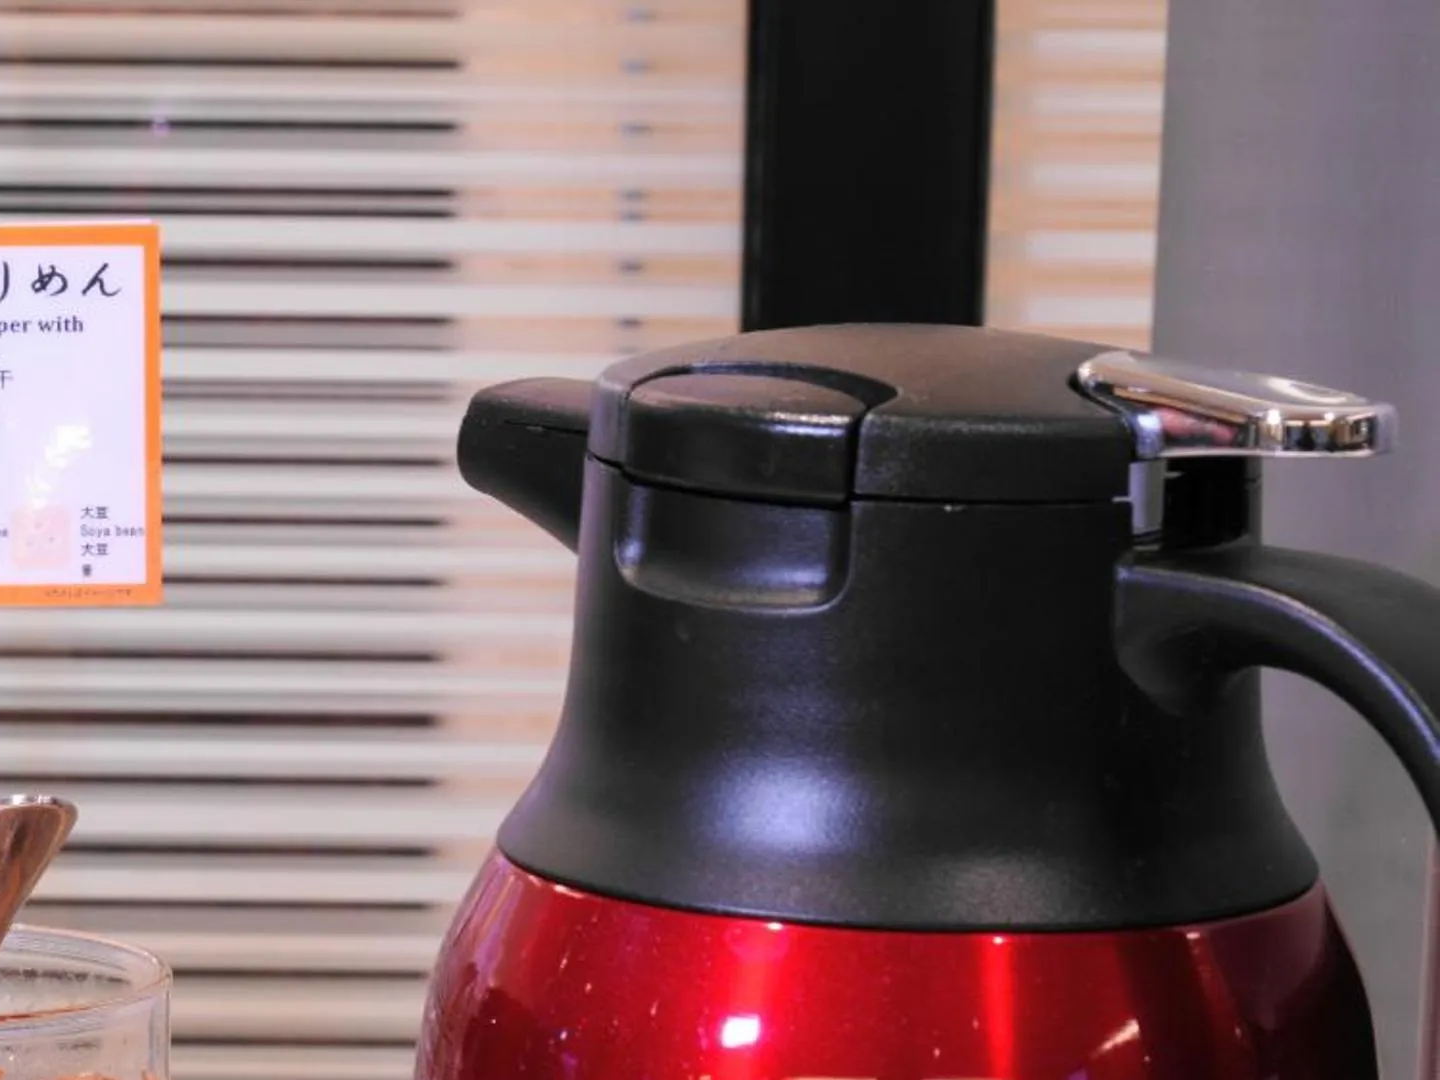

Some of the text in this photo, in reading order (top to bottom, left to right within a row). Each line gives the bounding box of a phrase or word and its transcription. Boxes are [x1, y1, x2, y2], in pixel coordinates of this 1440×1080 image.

[38, 315, 83, 333] with
[81, 506, 108, 519] 大豆
[81, 543, 108, 556] 大豆
